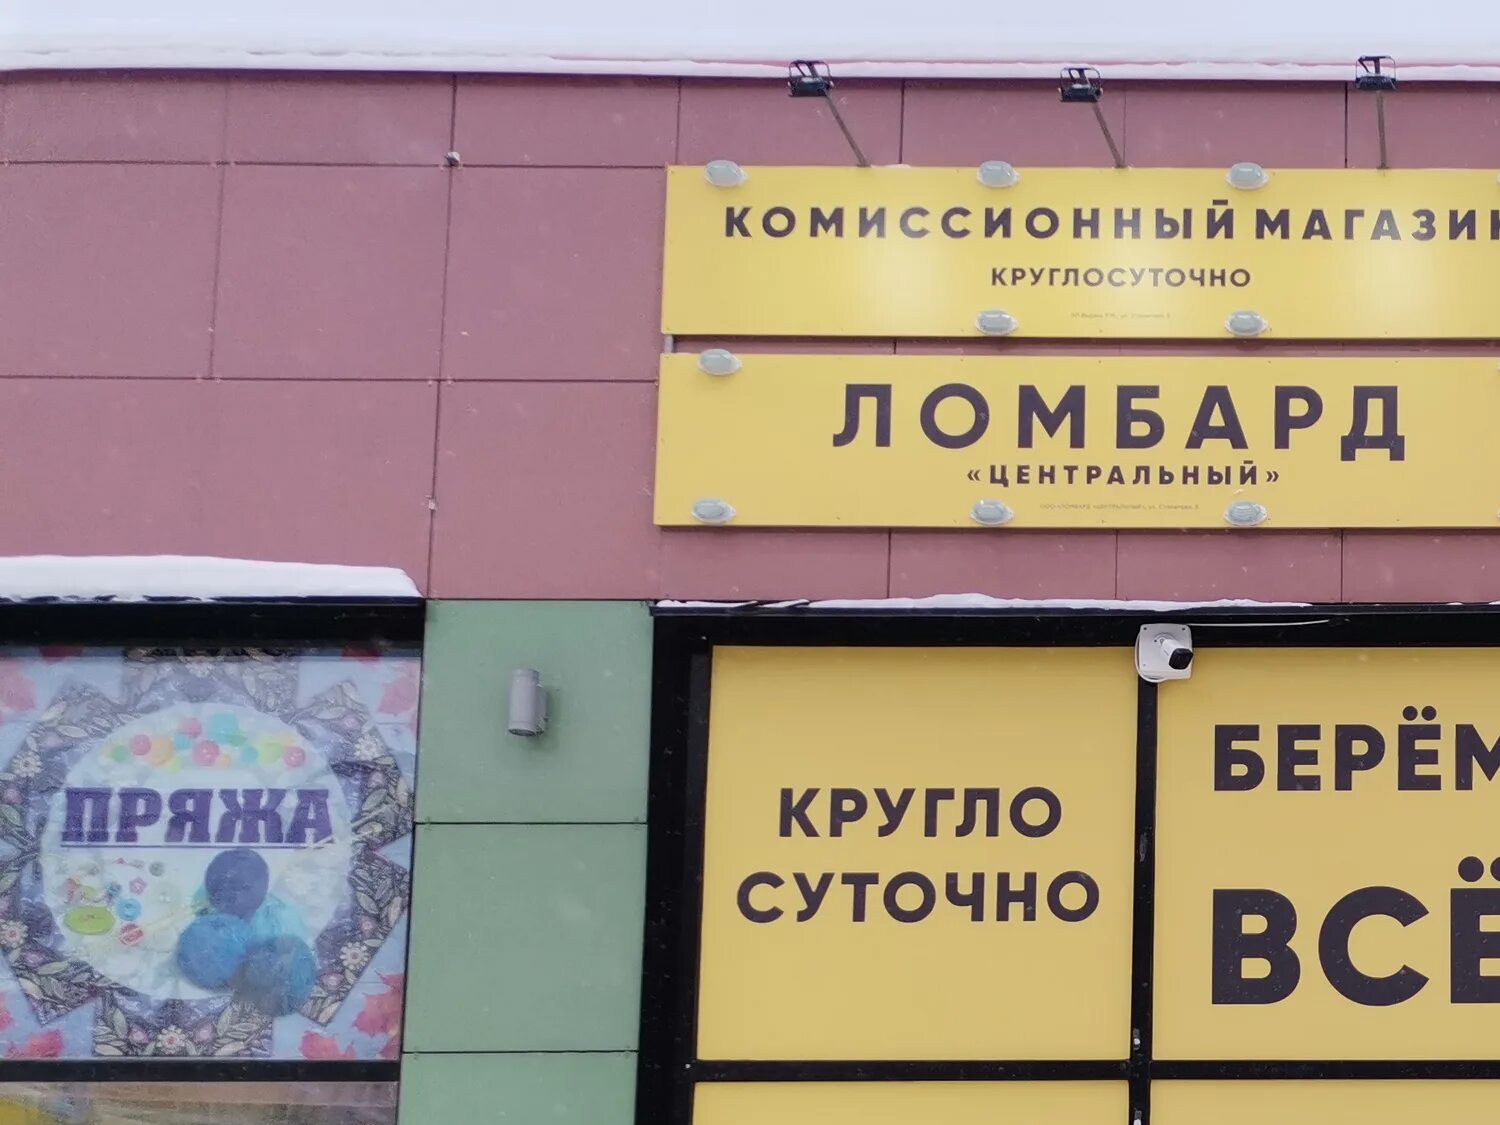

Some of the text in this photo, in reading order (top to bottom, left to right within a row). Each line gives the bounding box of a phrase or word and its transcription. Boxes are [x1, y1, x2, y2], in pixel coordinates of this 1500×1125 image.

[724, 199, 1234, 241] КОМИССИОННЫЙ
[991, 266, 1252, 289] КРУГЛОСУТОЧНО
[833, 382, 1405, 462] ЛОМБАРД
[966, 461, 1281, 487] «ЦЕНТРАЛЬНЫЙ»
[61, 786, 335, 845] ПРЯЖА
[778, 785, 1063, 839] КРУГЛО
[735, 869, 1101, 924] СУТОЧНО
